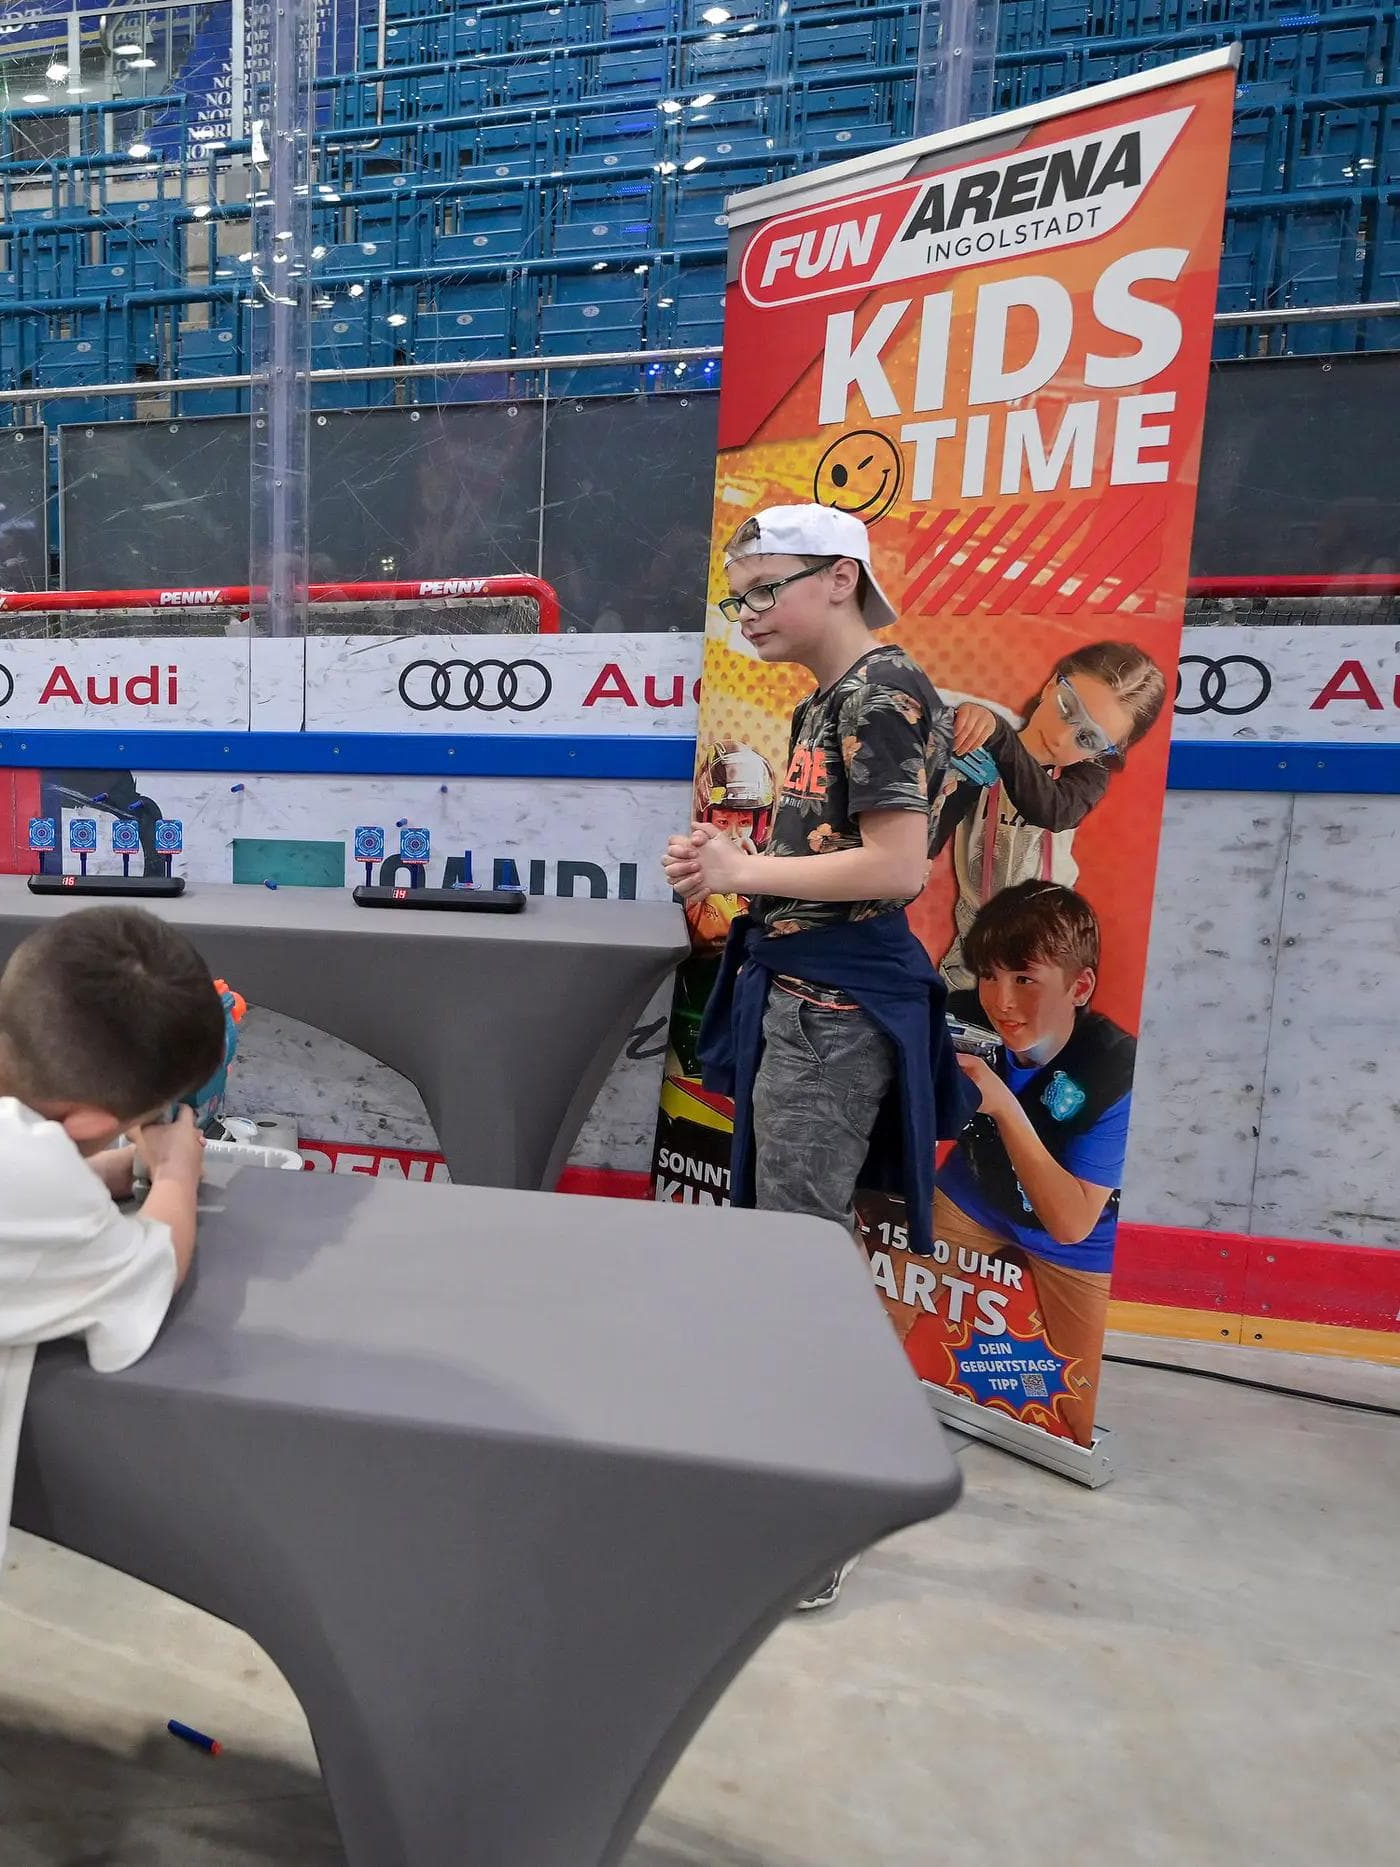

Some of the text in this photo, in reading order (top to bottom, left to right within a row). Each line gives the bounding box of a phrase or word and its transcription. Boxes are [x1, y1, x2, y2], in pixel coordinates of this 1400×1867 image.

[760, 130, 1142, 288] FUN ARENA
[926, 207, 1102, 264] INGOLSTADT
[818, 247, 1190, 426] KIDS
[900, 391, 1177, 501] TIME
[38, 665, 178, 706] Audi
[582, 663, 702, 708] Au
[1308, 660, 1400, 711] A
[655, 1174, 731, 1208] KIN
[658, 1147, 732, 1191] SONNT
[958, 1247, 1024, 1292] UHR
[868, 1250, 1009, 1337] ARTS
[959, 1358, 1062, 1373] GEBURTSTAGS-
[978, 1342, 1013, 1356] DEIN
[988, 1377, 1019, 1391] TIPP
